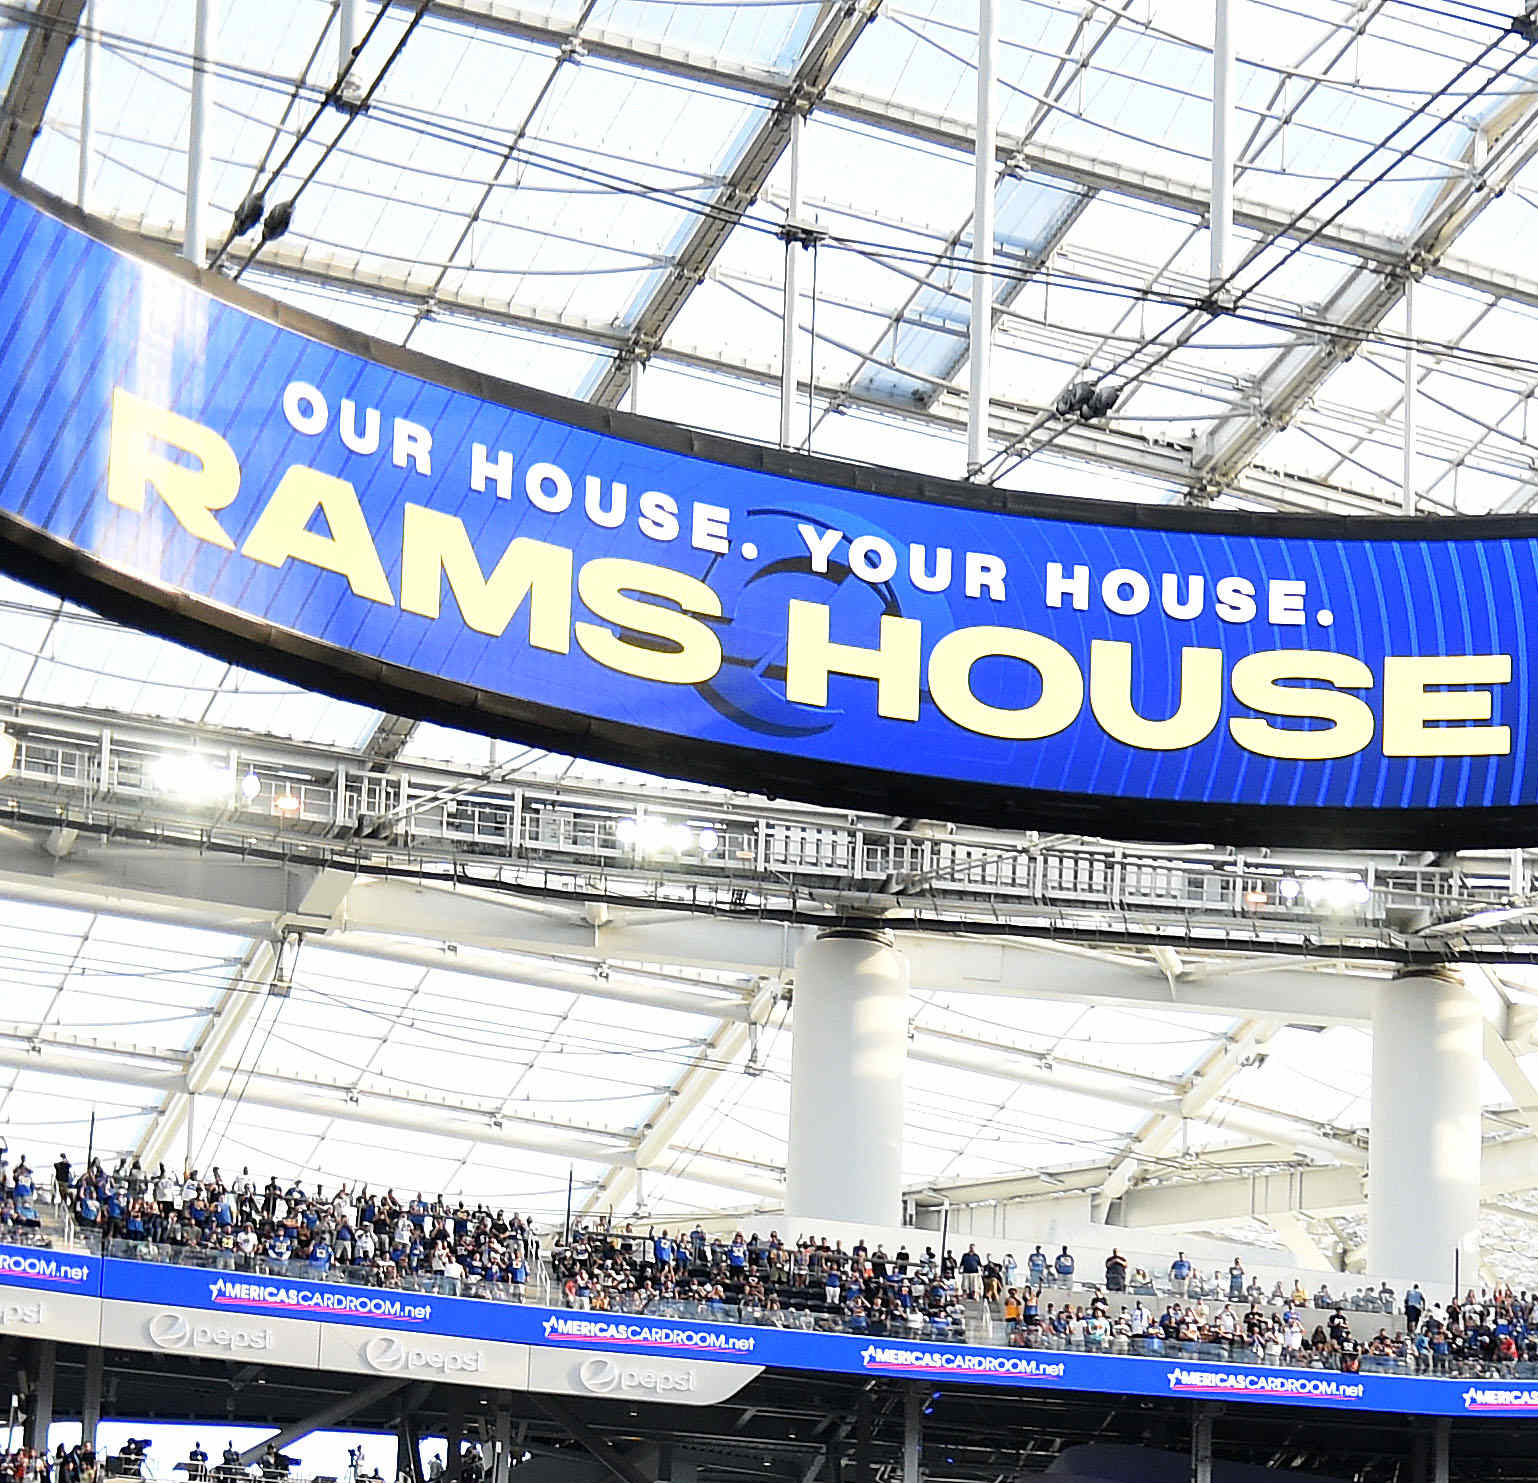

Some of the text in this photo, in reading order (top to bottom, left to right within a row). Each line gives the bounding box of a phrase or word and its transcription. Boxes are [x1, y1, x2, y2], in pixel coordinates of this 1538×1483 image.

[106, 387, 1513, 760] RAMS HOUSE
[283, 378, 1336, 628] OUR HOUSE. YOUR HOUSE.
